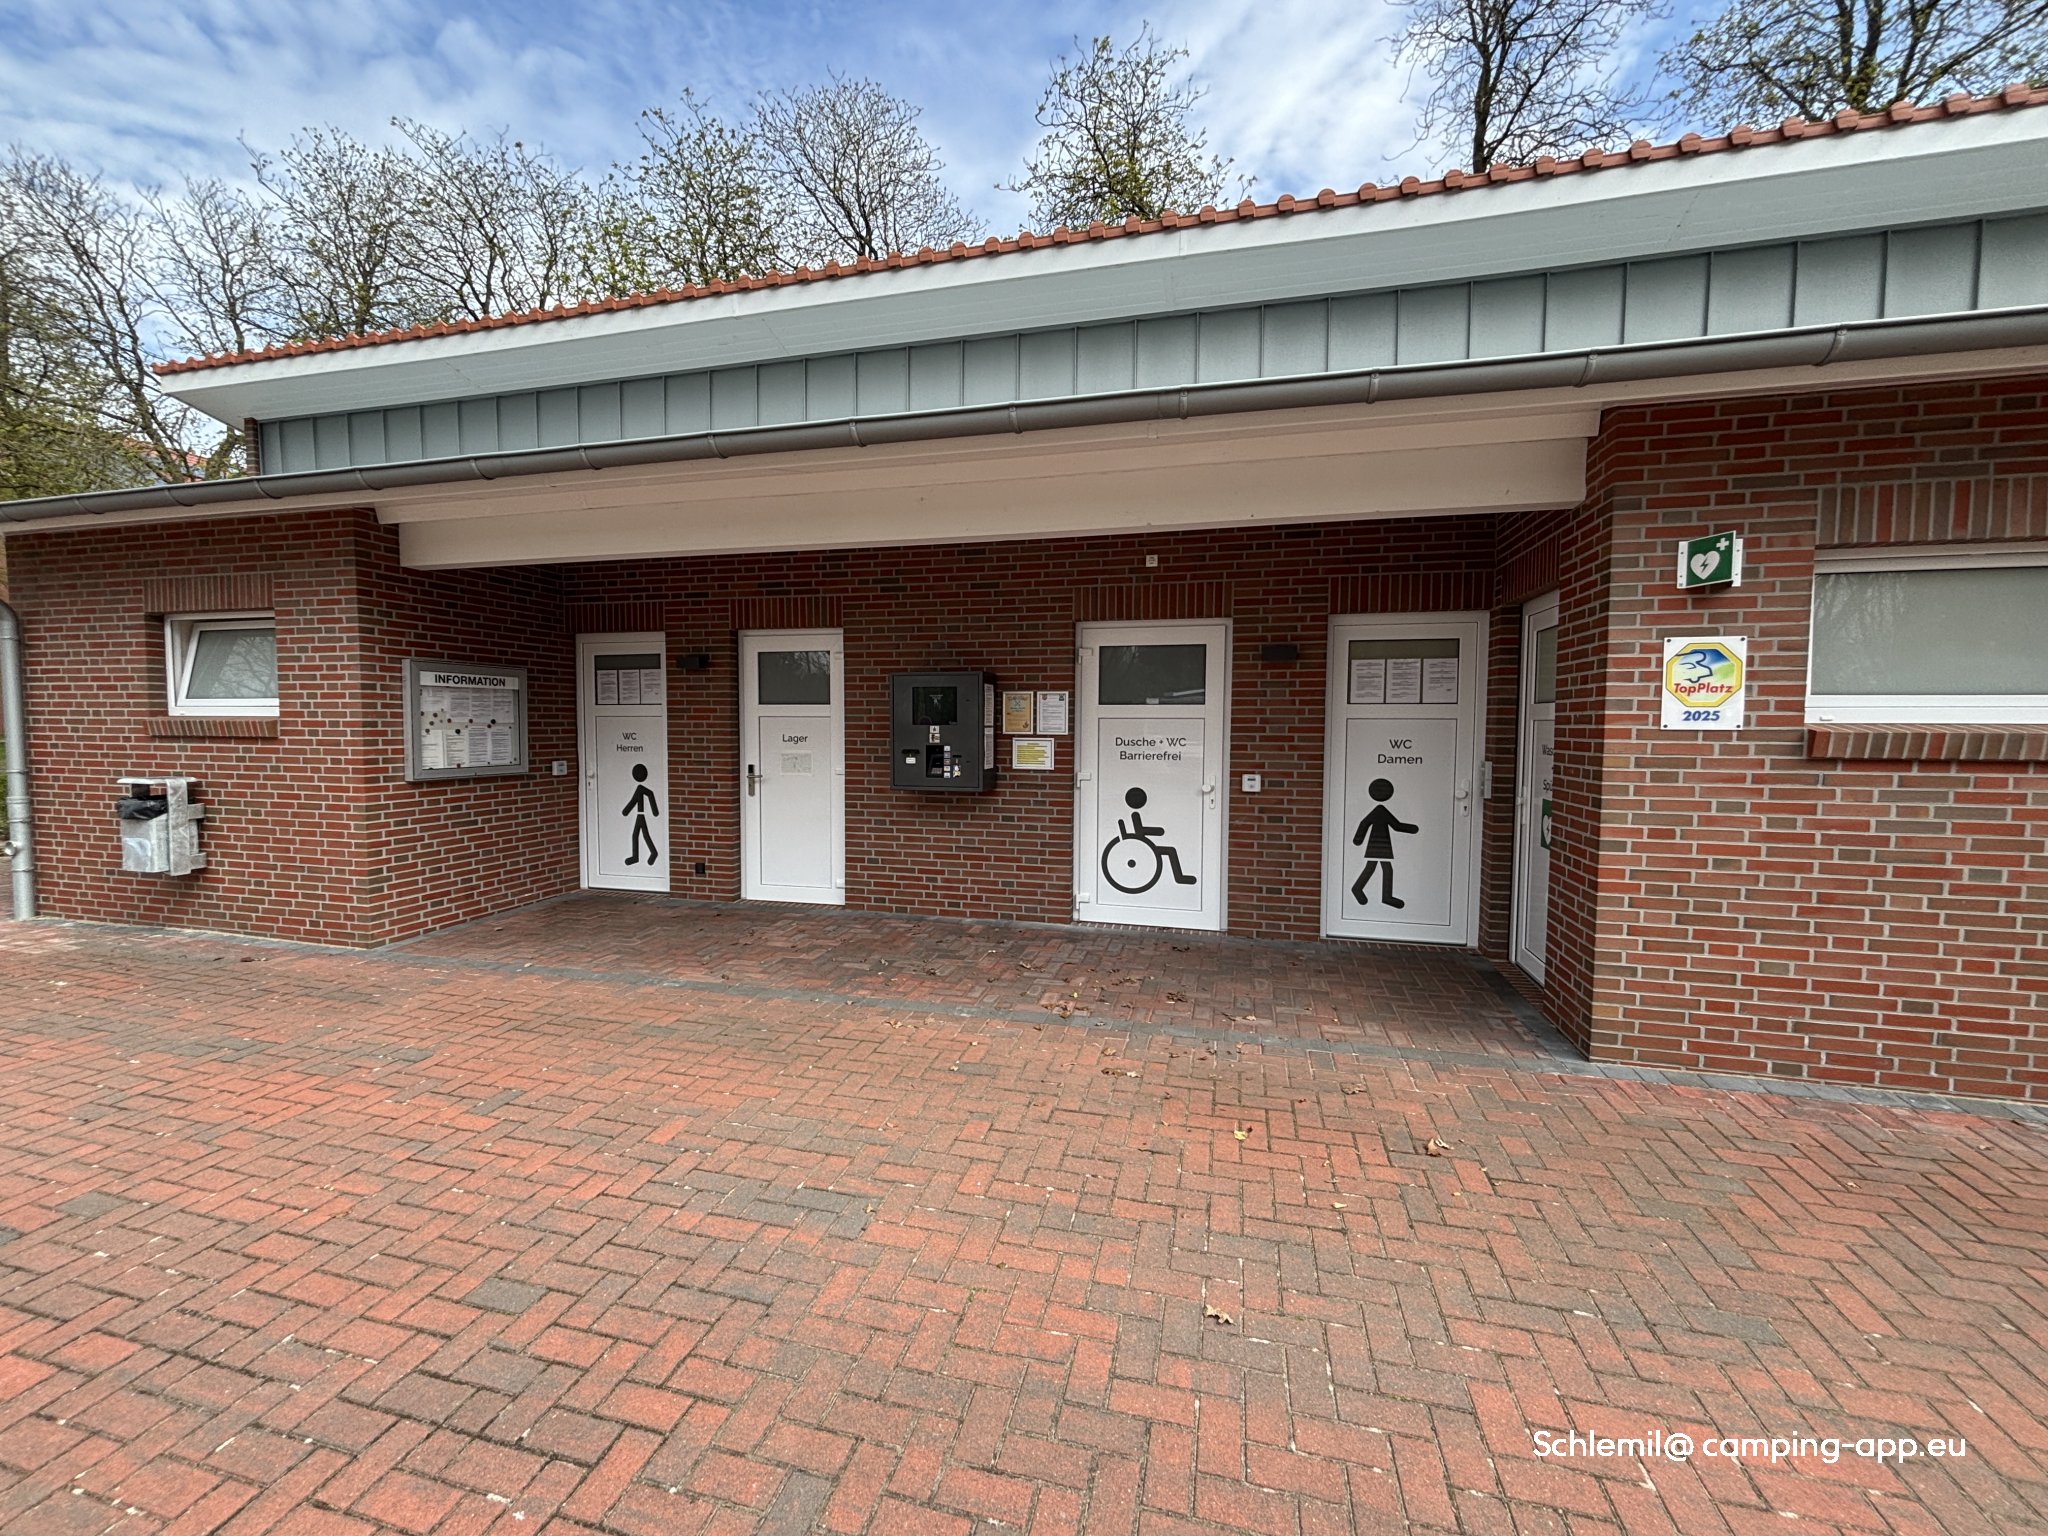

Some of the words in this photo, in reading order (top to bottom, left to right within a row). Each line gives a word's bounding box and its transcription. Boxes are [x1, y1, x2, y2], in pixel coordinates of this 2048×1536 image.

[434, 674, 506, 687] INFORMATION
[1673, 682, 1733, 697] TopPlatz
[1682, 710, 1720, 721] 2025
[622, 732, 637, 740] WC
[782, 733, 808, 745] Lager
[1115, 736, 1156, 747] Dusche
[1166, 737, 1187, 747] WC
[616, 743, 644, 752] Herren
[1389, 739, 1412, 749] WC
[1119, 750, 1182, 761] Barrierefrei
[1377, 753, 1423, 764] Damen
